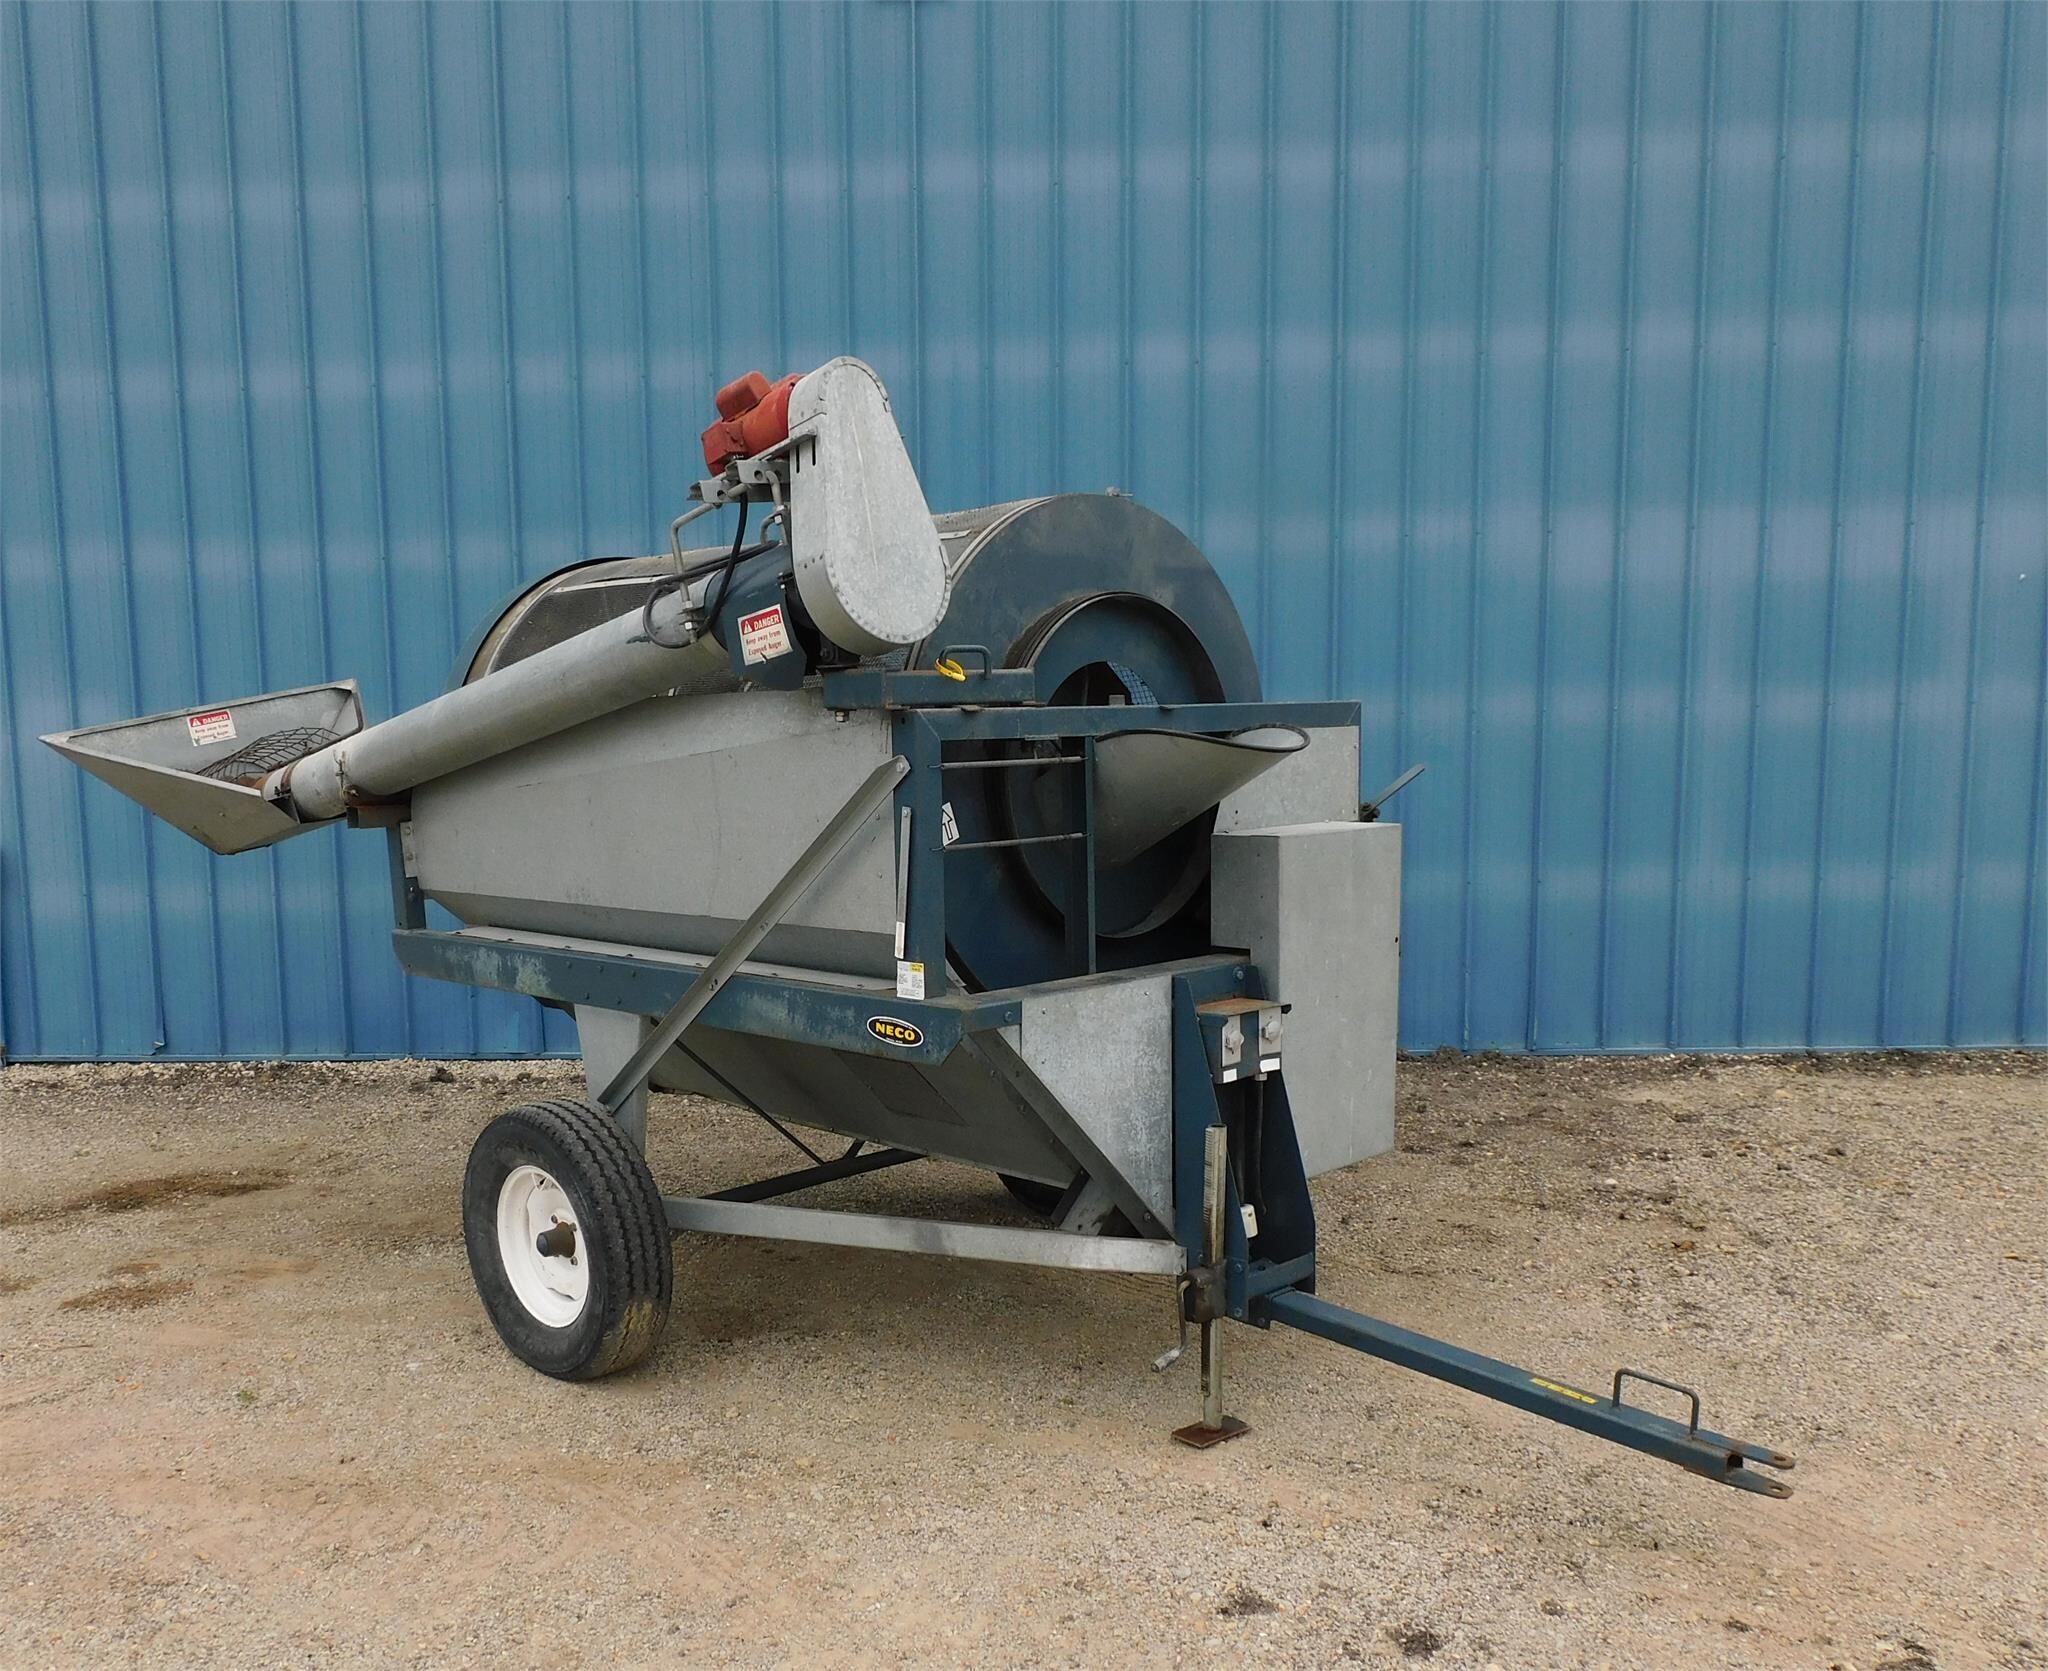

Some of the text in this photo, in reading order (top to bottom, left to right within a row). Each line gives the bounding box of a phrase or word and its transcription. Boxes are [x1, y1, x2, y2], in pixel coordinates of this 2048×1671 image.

[753, 614, 780, 630] DANGER
[202, 714, 229, 724] DANGER
[876, 1022, 915, 1040] NECO
